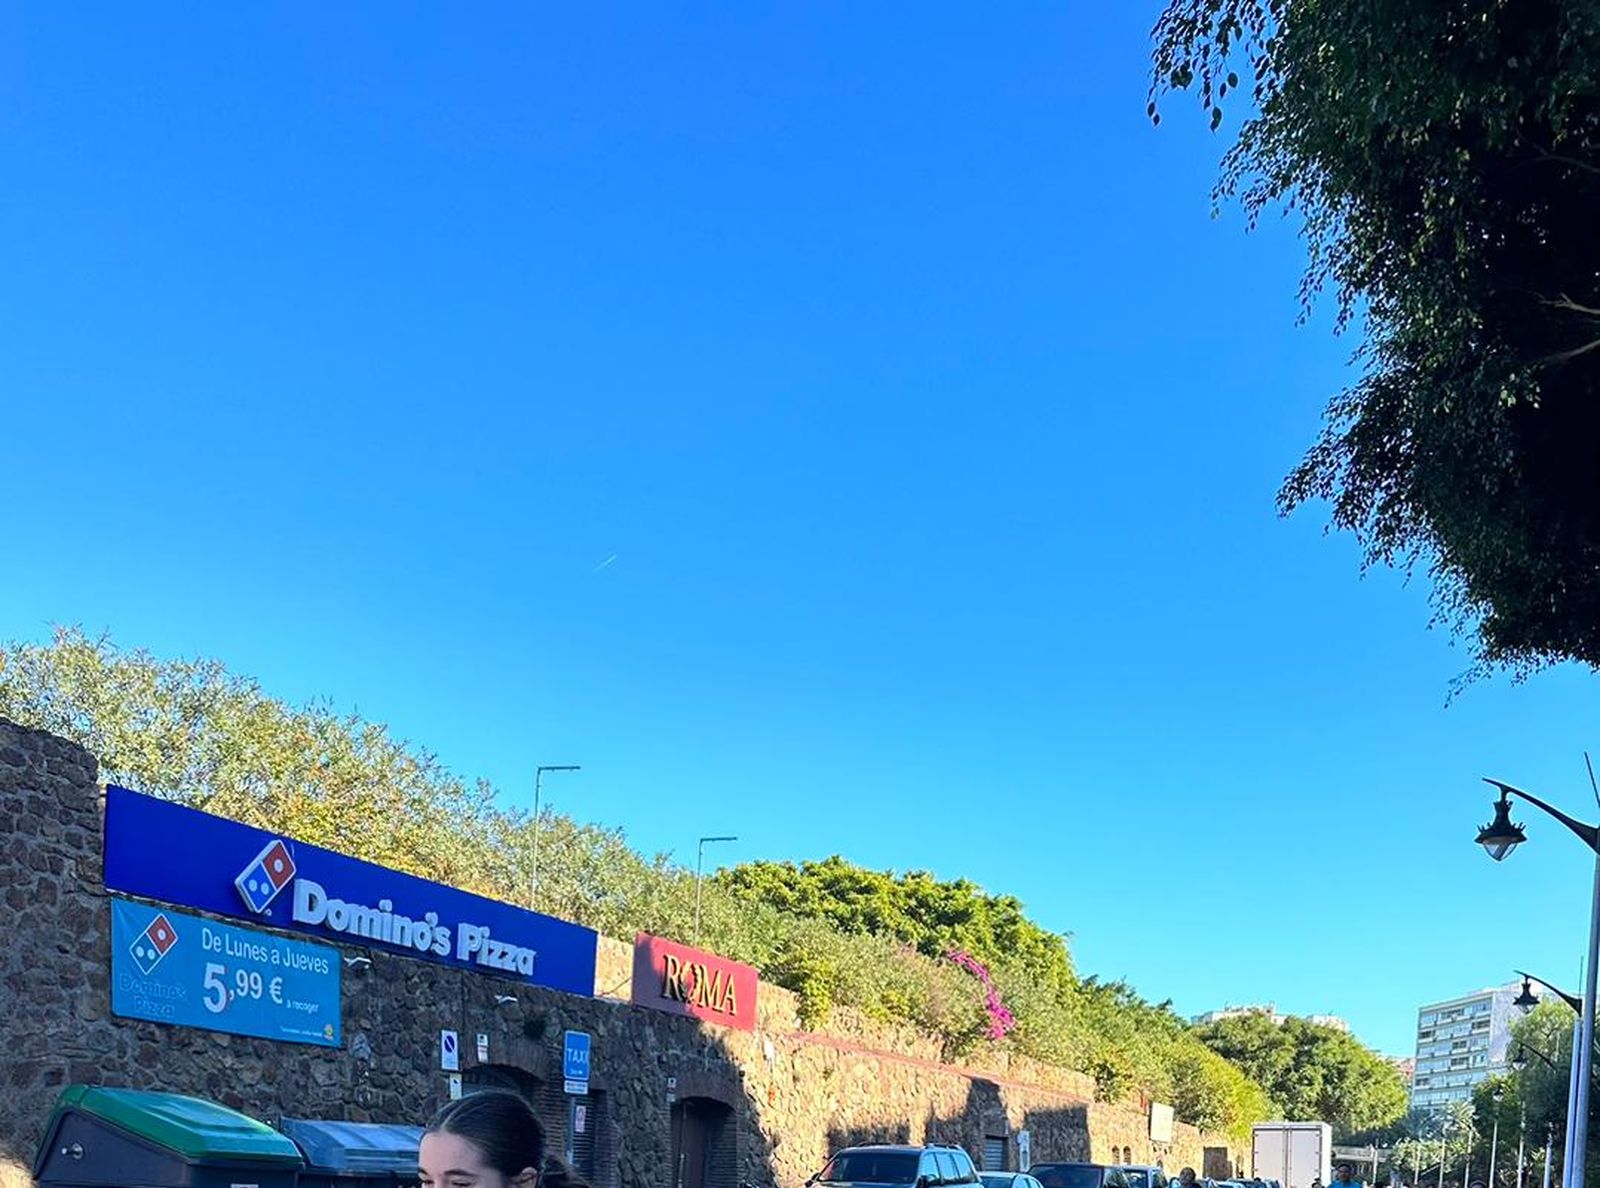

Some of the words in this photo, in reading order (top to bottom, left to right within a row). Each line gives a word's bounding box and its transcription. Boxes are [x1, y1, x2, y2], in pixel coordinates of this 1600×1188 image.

[202, 928, 222, 952] De
[225, 932, 268, 962] Lunes
[271, 949, 280, 961] a
[282, 947, 329, 975] Jueves
[293, 878, 451, 956] Domino's
[457, 922, 537, 976] Pizza
[203, 962, 262, 1013] 5,99
[269, 976, 283, 1004] €
[661, 954, 736, 1016] ROMA
[567, 1048, 588, 1063] TAXI
